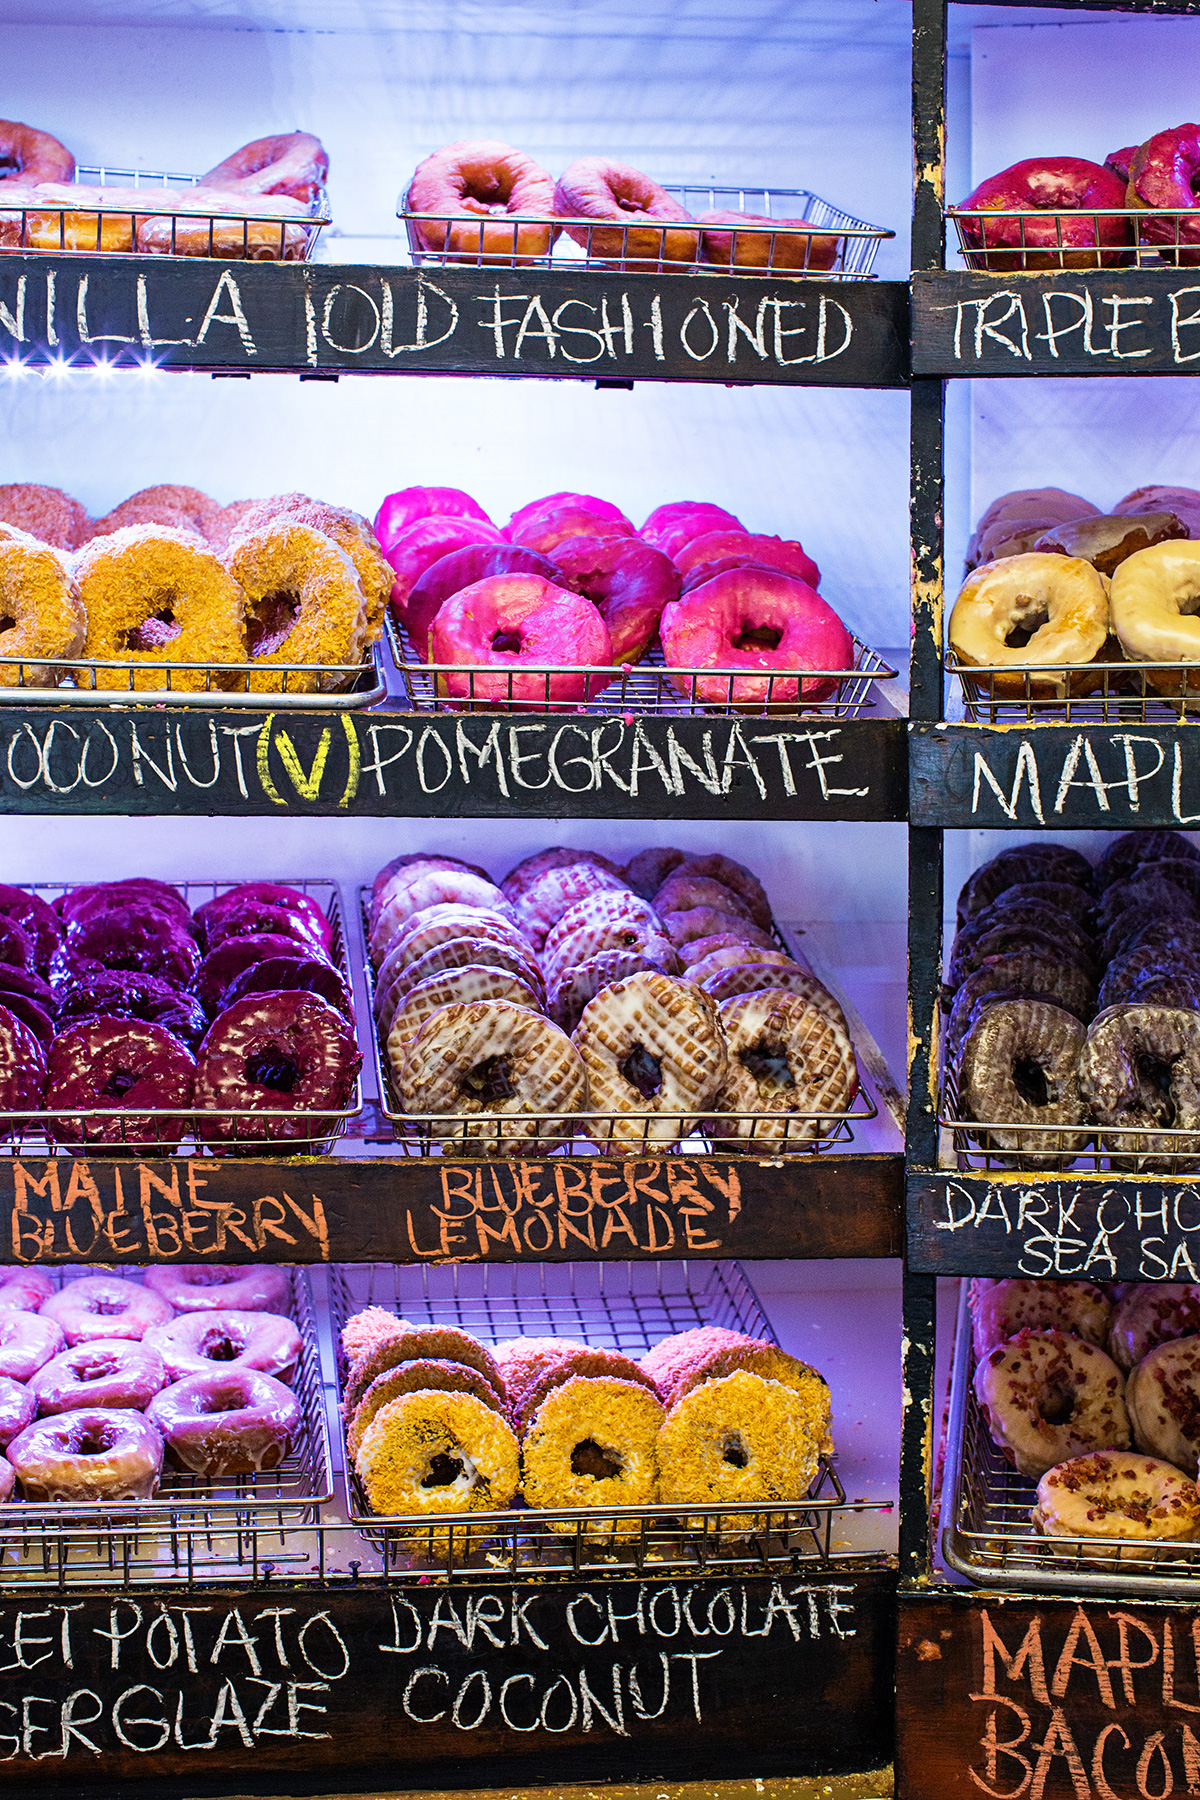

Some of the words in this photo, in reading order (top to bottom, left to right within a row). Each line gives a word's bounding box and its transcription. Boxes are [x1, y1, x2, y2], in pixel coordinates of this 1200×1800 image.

[322, 271, 458, 357] OLD
[473, 283, 857, 365] FASHIONED
[929, 285, 1153, 361] TRIPLE
[7, 718, 265, 799] OCONUT
[256, 712, 361, 808] (V)
[361, 717, 870, 800] POMEGRANATE
[971, 734, 1200, 824] MAPL
[12, 1160, 235, 1223] MAINE
[12, 1191, 330, 1261] BLUEBERRY
[430, 1160, 742, 1223] BLUEBERRY
[932, 1182, 1082, 1241] DARK
[406, 1204, 723, 1256] LEMONADE
[1017, 1230, 1118, 1278] SEA
[1139, 1236, 1200, 1283] SA
[93, 1597, 349, 1680] POTATO
[379, 1591, 549, 1652] DARK
[566, 1580, 857, 1645] CHOCOLATE
[402, 1649, 723, 1738] COCONUT
[980, 1605, 1200, 1713] MAPL
[112, 1675, 333, 1751] GLAZE
